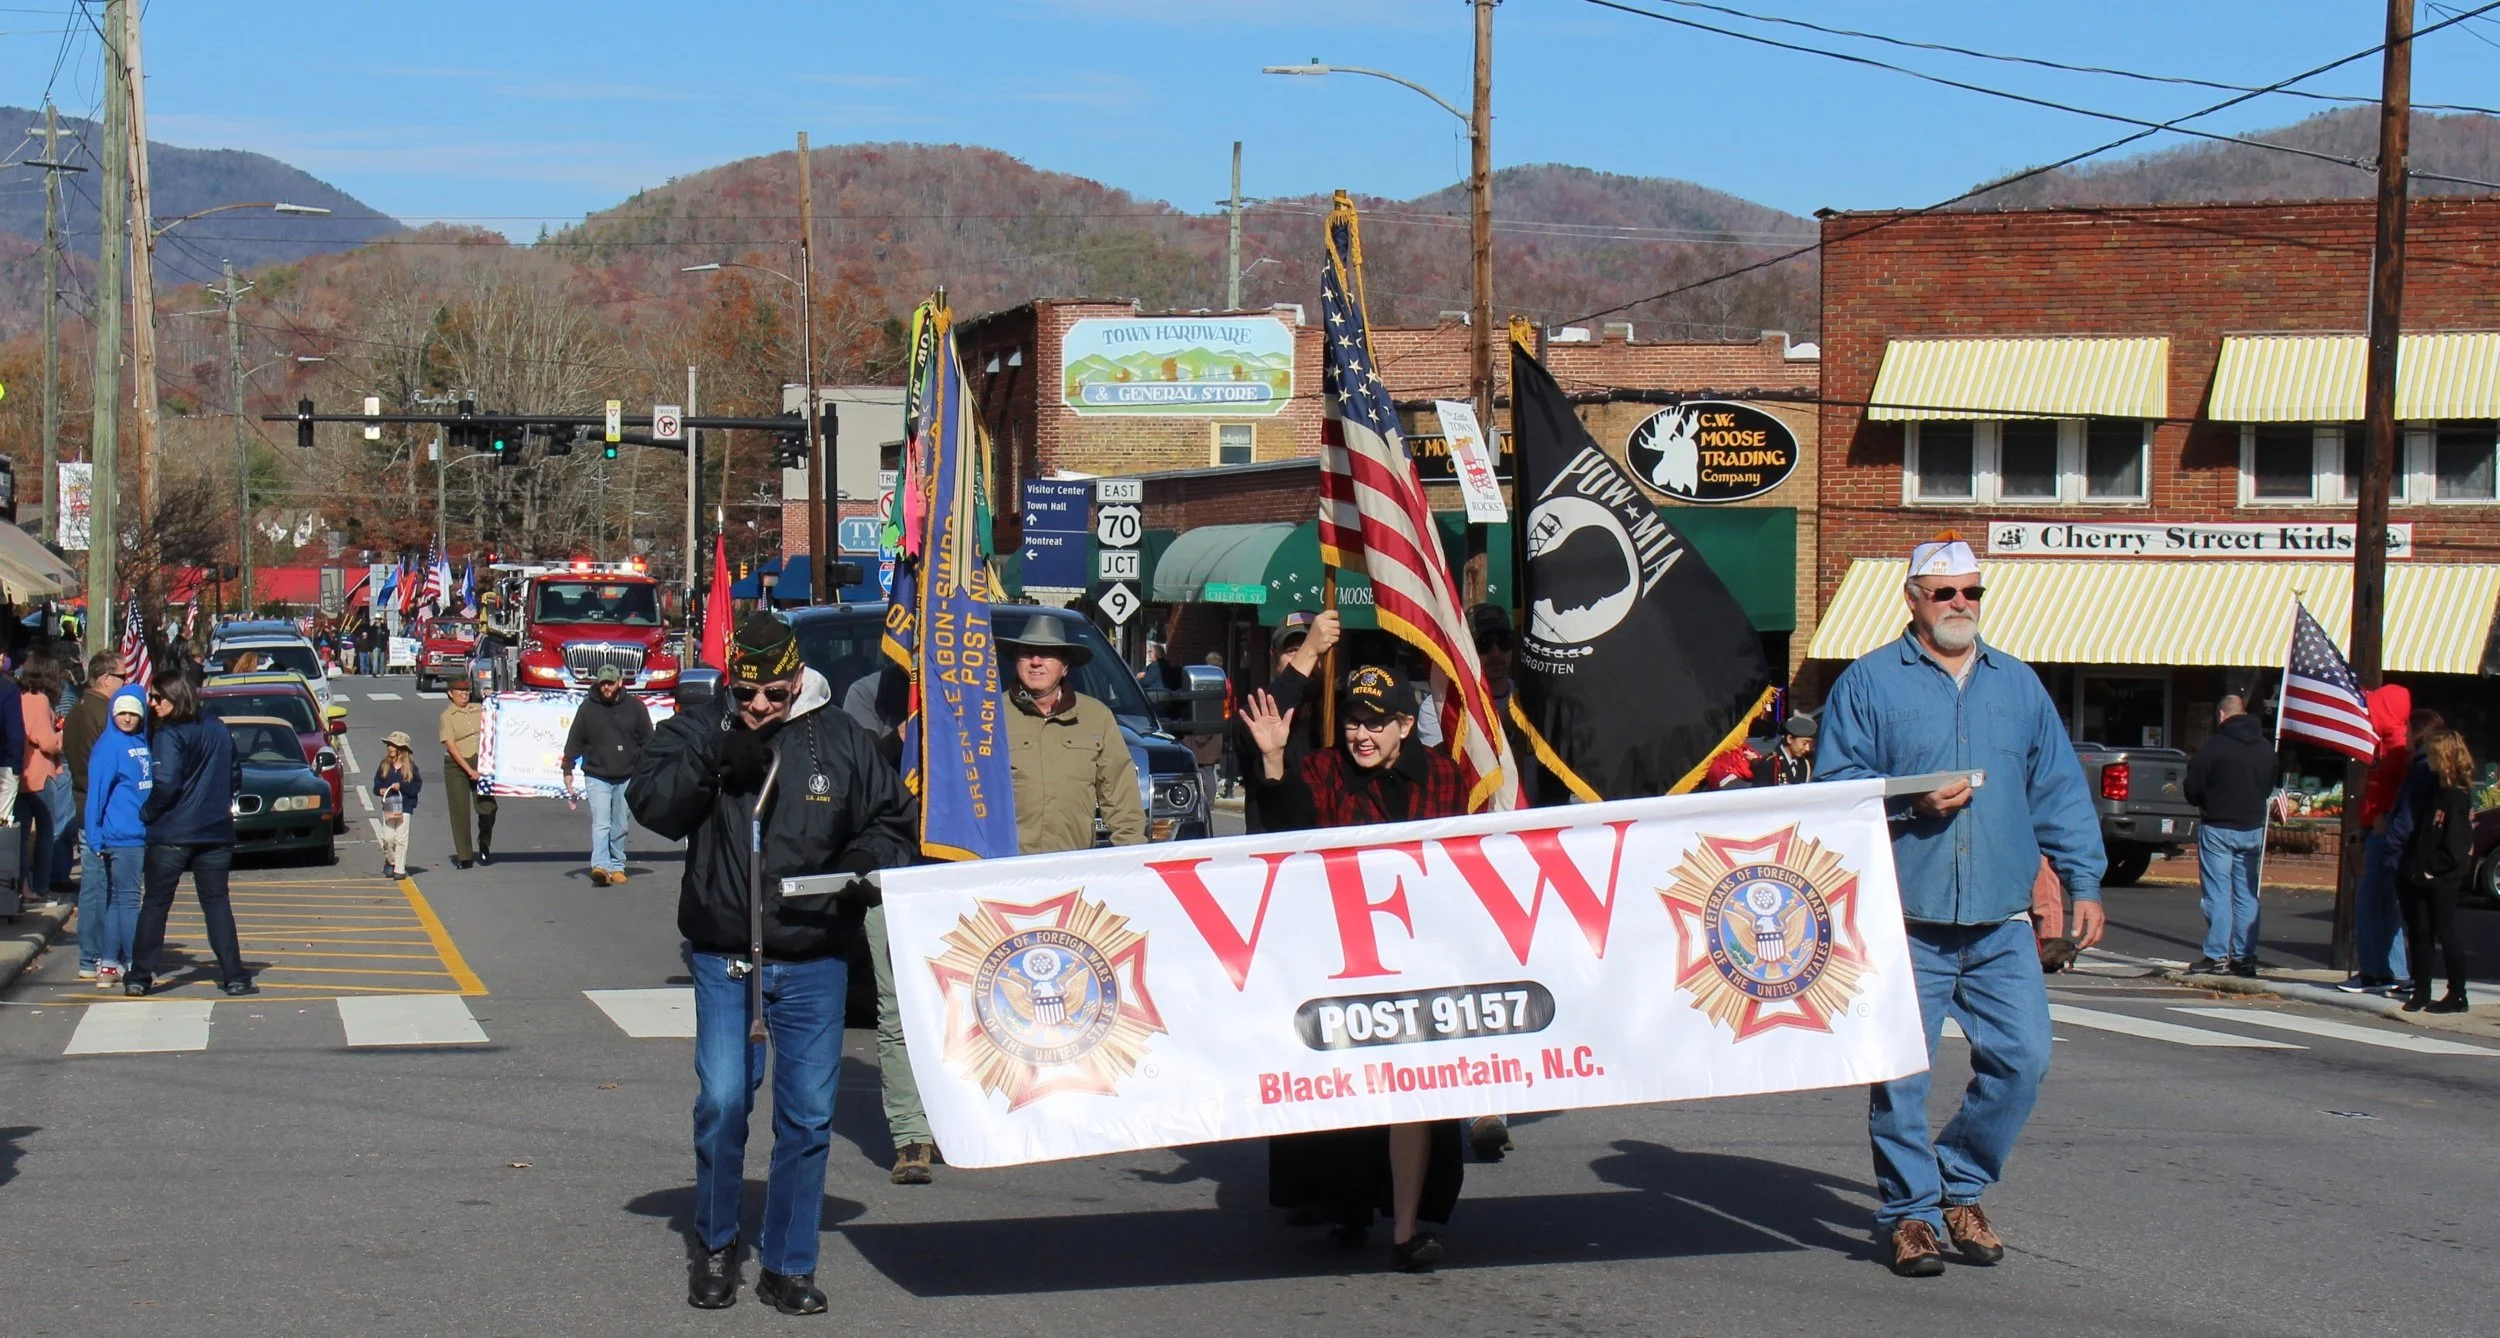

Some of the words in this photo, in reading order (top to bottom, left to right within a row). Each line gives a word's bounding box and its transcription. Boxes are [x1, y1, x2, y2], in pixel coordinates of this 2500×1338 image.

[916, 317, 930, 368] OW
[1102, 326, 1151, 346] TOWN
[1156, 324, 1253, 345] HARDWARE
[909, 379, 922, 420] MIA
[1095, 385, 1109, 401] &
[1118, 386, 1198, 402] GENERAL
[1201, 385, 1259, 401] STORE
[1448, 421, 1474, 433] TOWN
[1700, 413, 1736, 428] C.W.
[1700, 431, 1767, 447] MOOSE
[1700, 450, 1787, 467] TRADING
[880, 474, 896, 484] TRU
[1701, 469, 1761, 487] Company
[1027, 484, 1055, 495] Visitor
[1057, 485, 1086, 496] Center
[1104, 485, 1136, 498] EAST
[1026, 501, 1048, 511] Town
[1050, 502, 1067, 512] Hall
[849, 521, 881, 538] TY
[1104, 514, 1136, 539] 70
[1537, 446, 1639, 508] POW
[1629, 510, 1685, 600] MIA
[1025, 536, 1063, 547] Montreat
[2040, 525, 2151, 554] Cherry
[2165, 526, 2265, 550] Street
[2277, 525, 2352, 550] Kids
[1103, 556, 1136, 573] JCT
[1112, 593, 1127, 616] 9
[1208, 590, 1247, 603] CHERRY
[885, 603, 916, 637] OF
[960, 612, 988, 686] POST
[741, 671, 758, 680] 9157
[742, 664, 758, 672] VFW
[1377, 668, 1394, 687] GUARD
[1352, 686, 1383, 697] VETERAN
[979, 700, 996, 756] BLACK
[816, 795, 831, 803] ARMY
[1144, 818, 1638, 992] VFW
[1706, 877, 1736, 930] VETERANS
[1736, 867, 1751, 882] OF
[1757, 866, 1805, 889] FOREIGN
[1805, 887, 1828, 921] WARS
[977, 942, 1012, 998] VETERANS
[1013, 934, 1030, 949] OF
[1036, 931, 1088, 954] FOREIGN
[1087, 951, 1113, 984] WARS
[1712, 950, 1726, 966] OF
[1727, 968, 1749, 989] THE
[1757, 981, 1798, 997] UNITED
[1804, 941, 1828, 982] STATES
[1318, 998, 1421, 1044] POST
[1431, 990, 1529, 1034] 9157
[984, 1017, 998, 1034] OF
[1001, 1034, 1025, 1056] THE
[1035, 1043, 1081, 1062] UNITED
[1087, 1001, 1115, 1044] STATES
[1258, 1067, 1357, 1105] Black
[1364, 1052, 1534, 1094] Mountain,
[1541, 1045, 1605, 1080] N.C.
